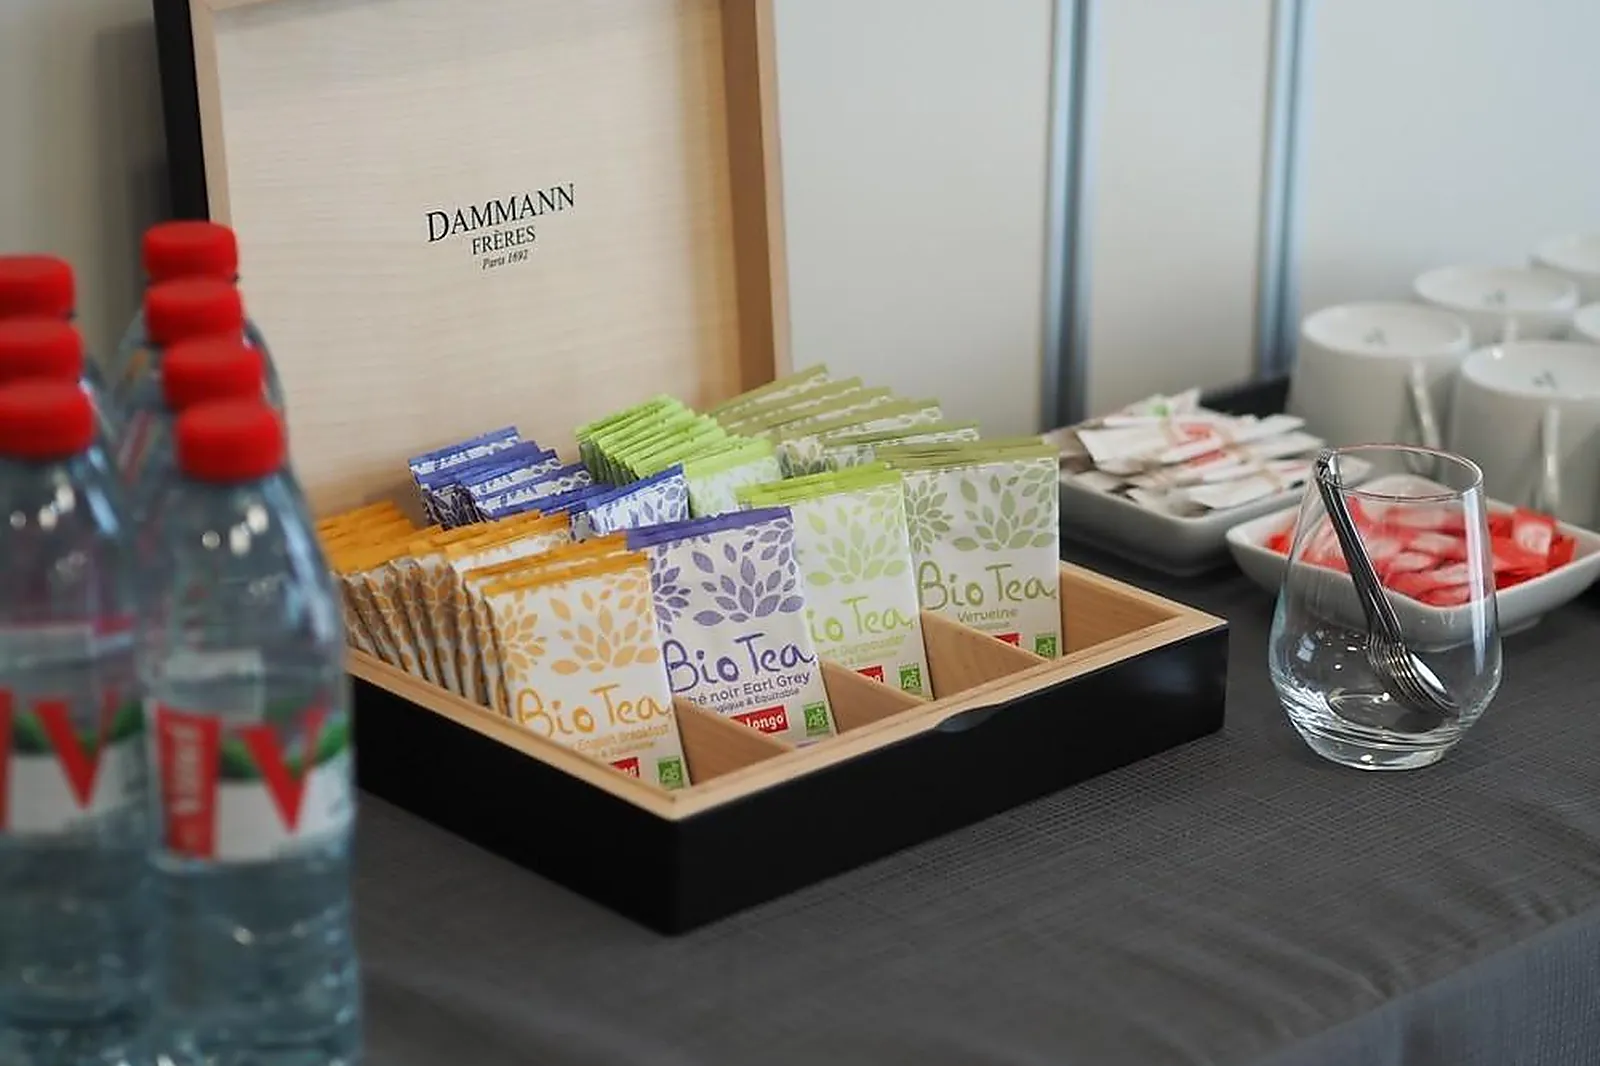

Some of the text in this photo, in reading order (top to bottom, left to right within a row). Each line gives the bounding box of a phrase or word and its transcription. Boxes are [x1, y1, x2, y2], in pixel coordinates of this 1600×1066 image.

[426, 183, 575, 243] DAMMANN
[472, 226, 536, 255] FRÈRES
[482, 255, 505, 270] Paris
[917, 560, 1057, 611] Bio Tea
[805, 596, 914, 642] io Tea
[662, 639, 740, 694] Bio
[734, 633, 817, 675] Tea
[517, 683, 671, 738] Bio Tea
[710, 687, 741, 704] noir
[743, 677, 773, 696] Earl
[776, 671, 811, 689] Grey
[744, 713, 786, 733] longo
